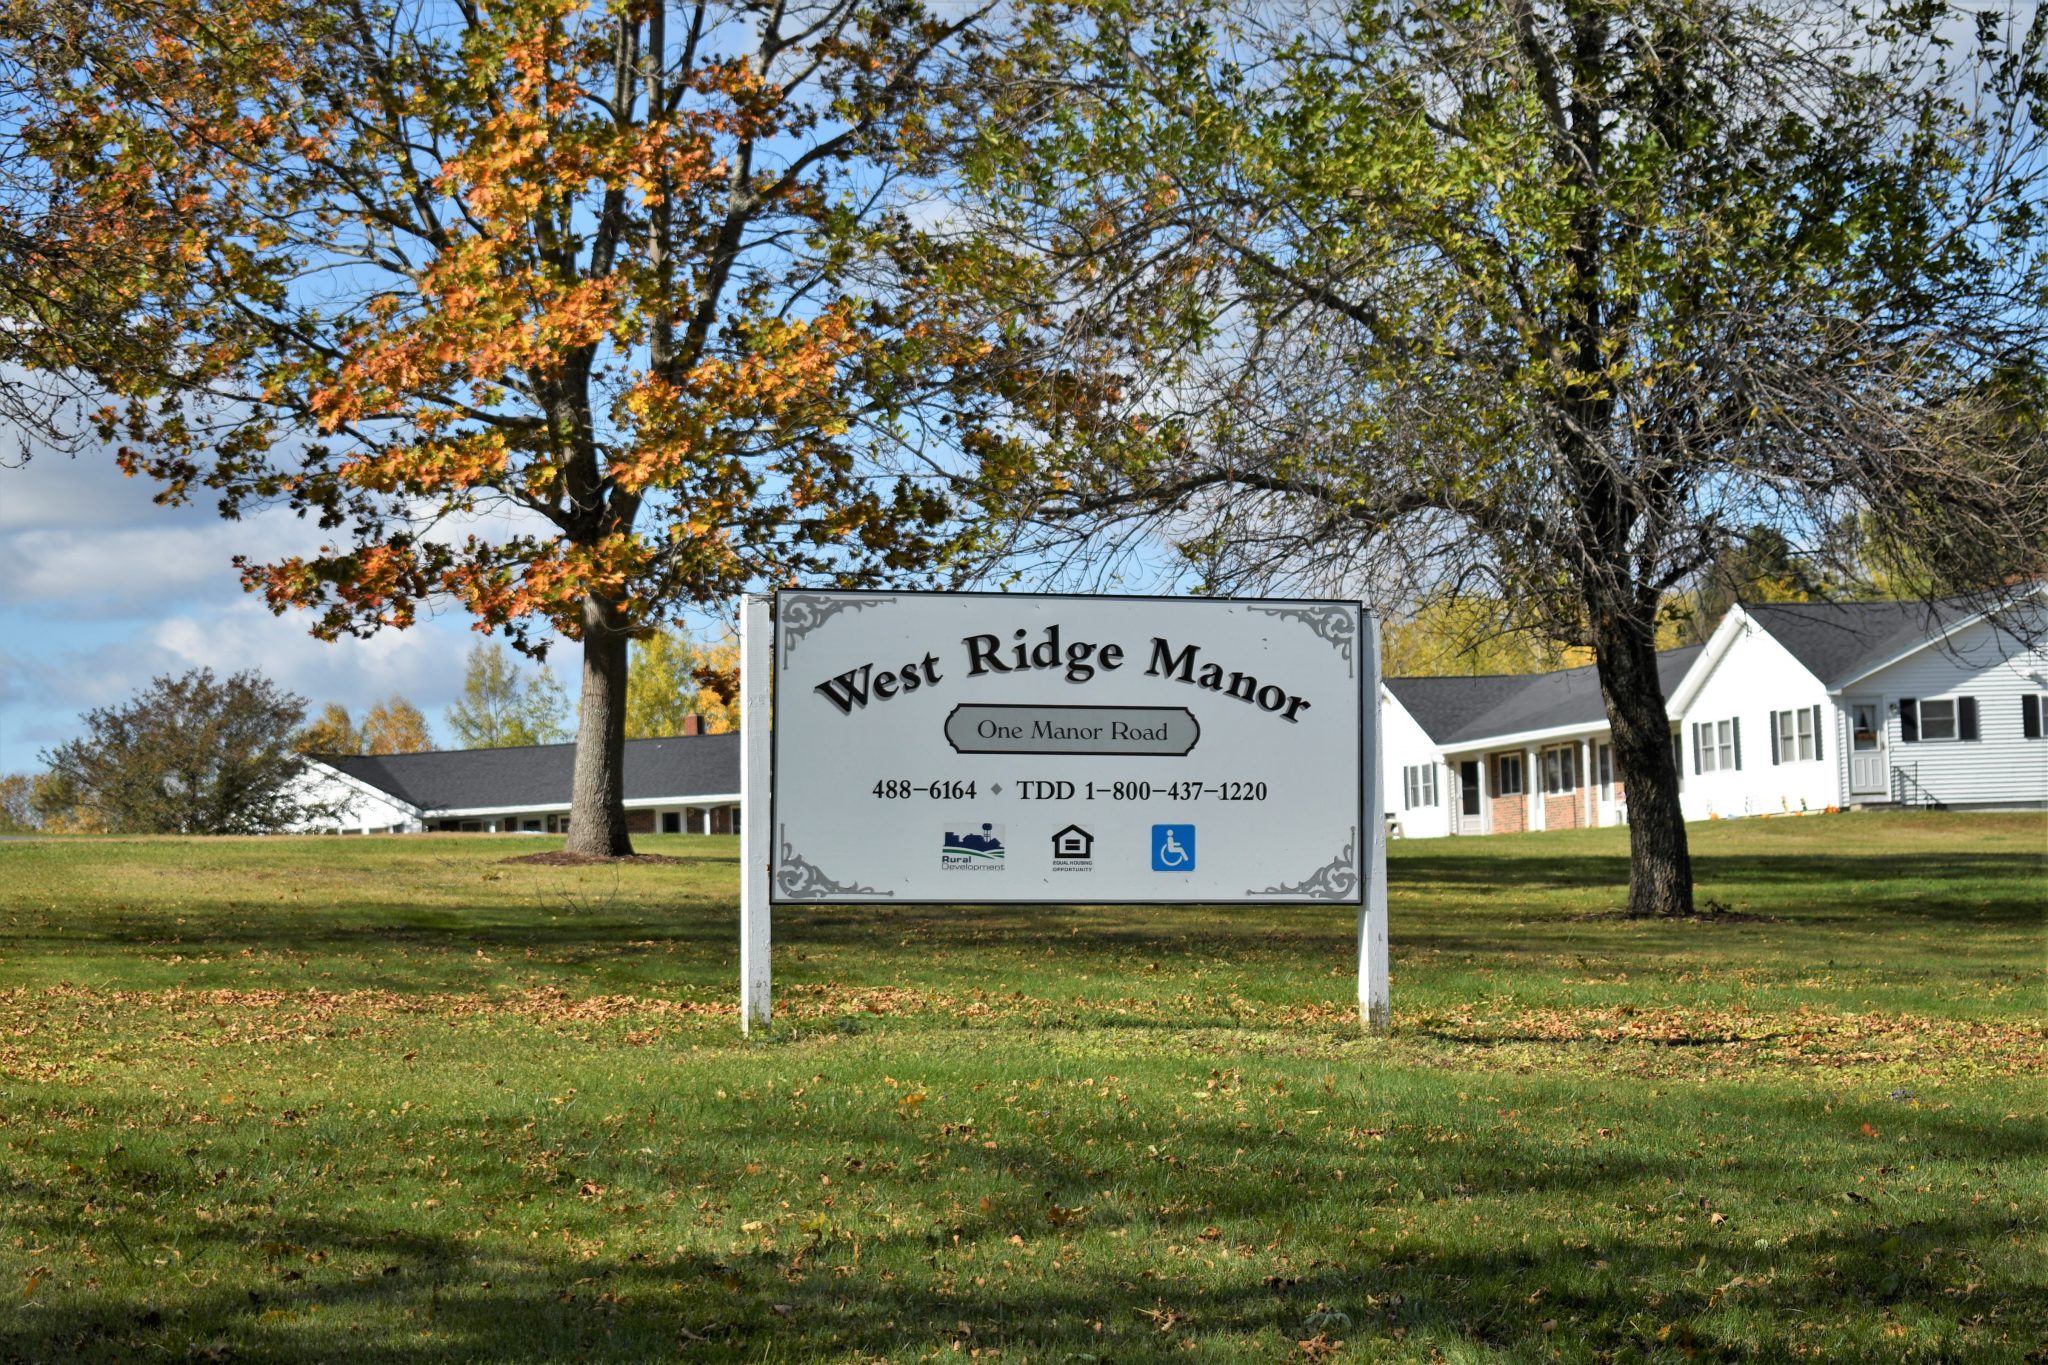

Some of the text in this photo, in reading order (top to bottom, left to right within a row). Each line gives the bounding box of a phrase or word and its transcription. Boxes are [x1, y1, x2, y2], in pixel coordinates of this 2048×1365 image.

[813, 624, 1312, 724] West Ridge Manor
[976, 719, 1170, 742] One Manor Road
[1015, 780, 1076, 800] TDD
[941, 855, 972, 863] Rural
[941, 863, 1005, 872] Development
